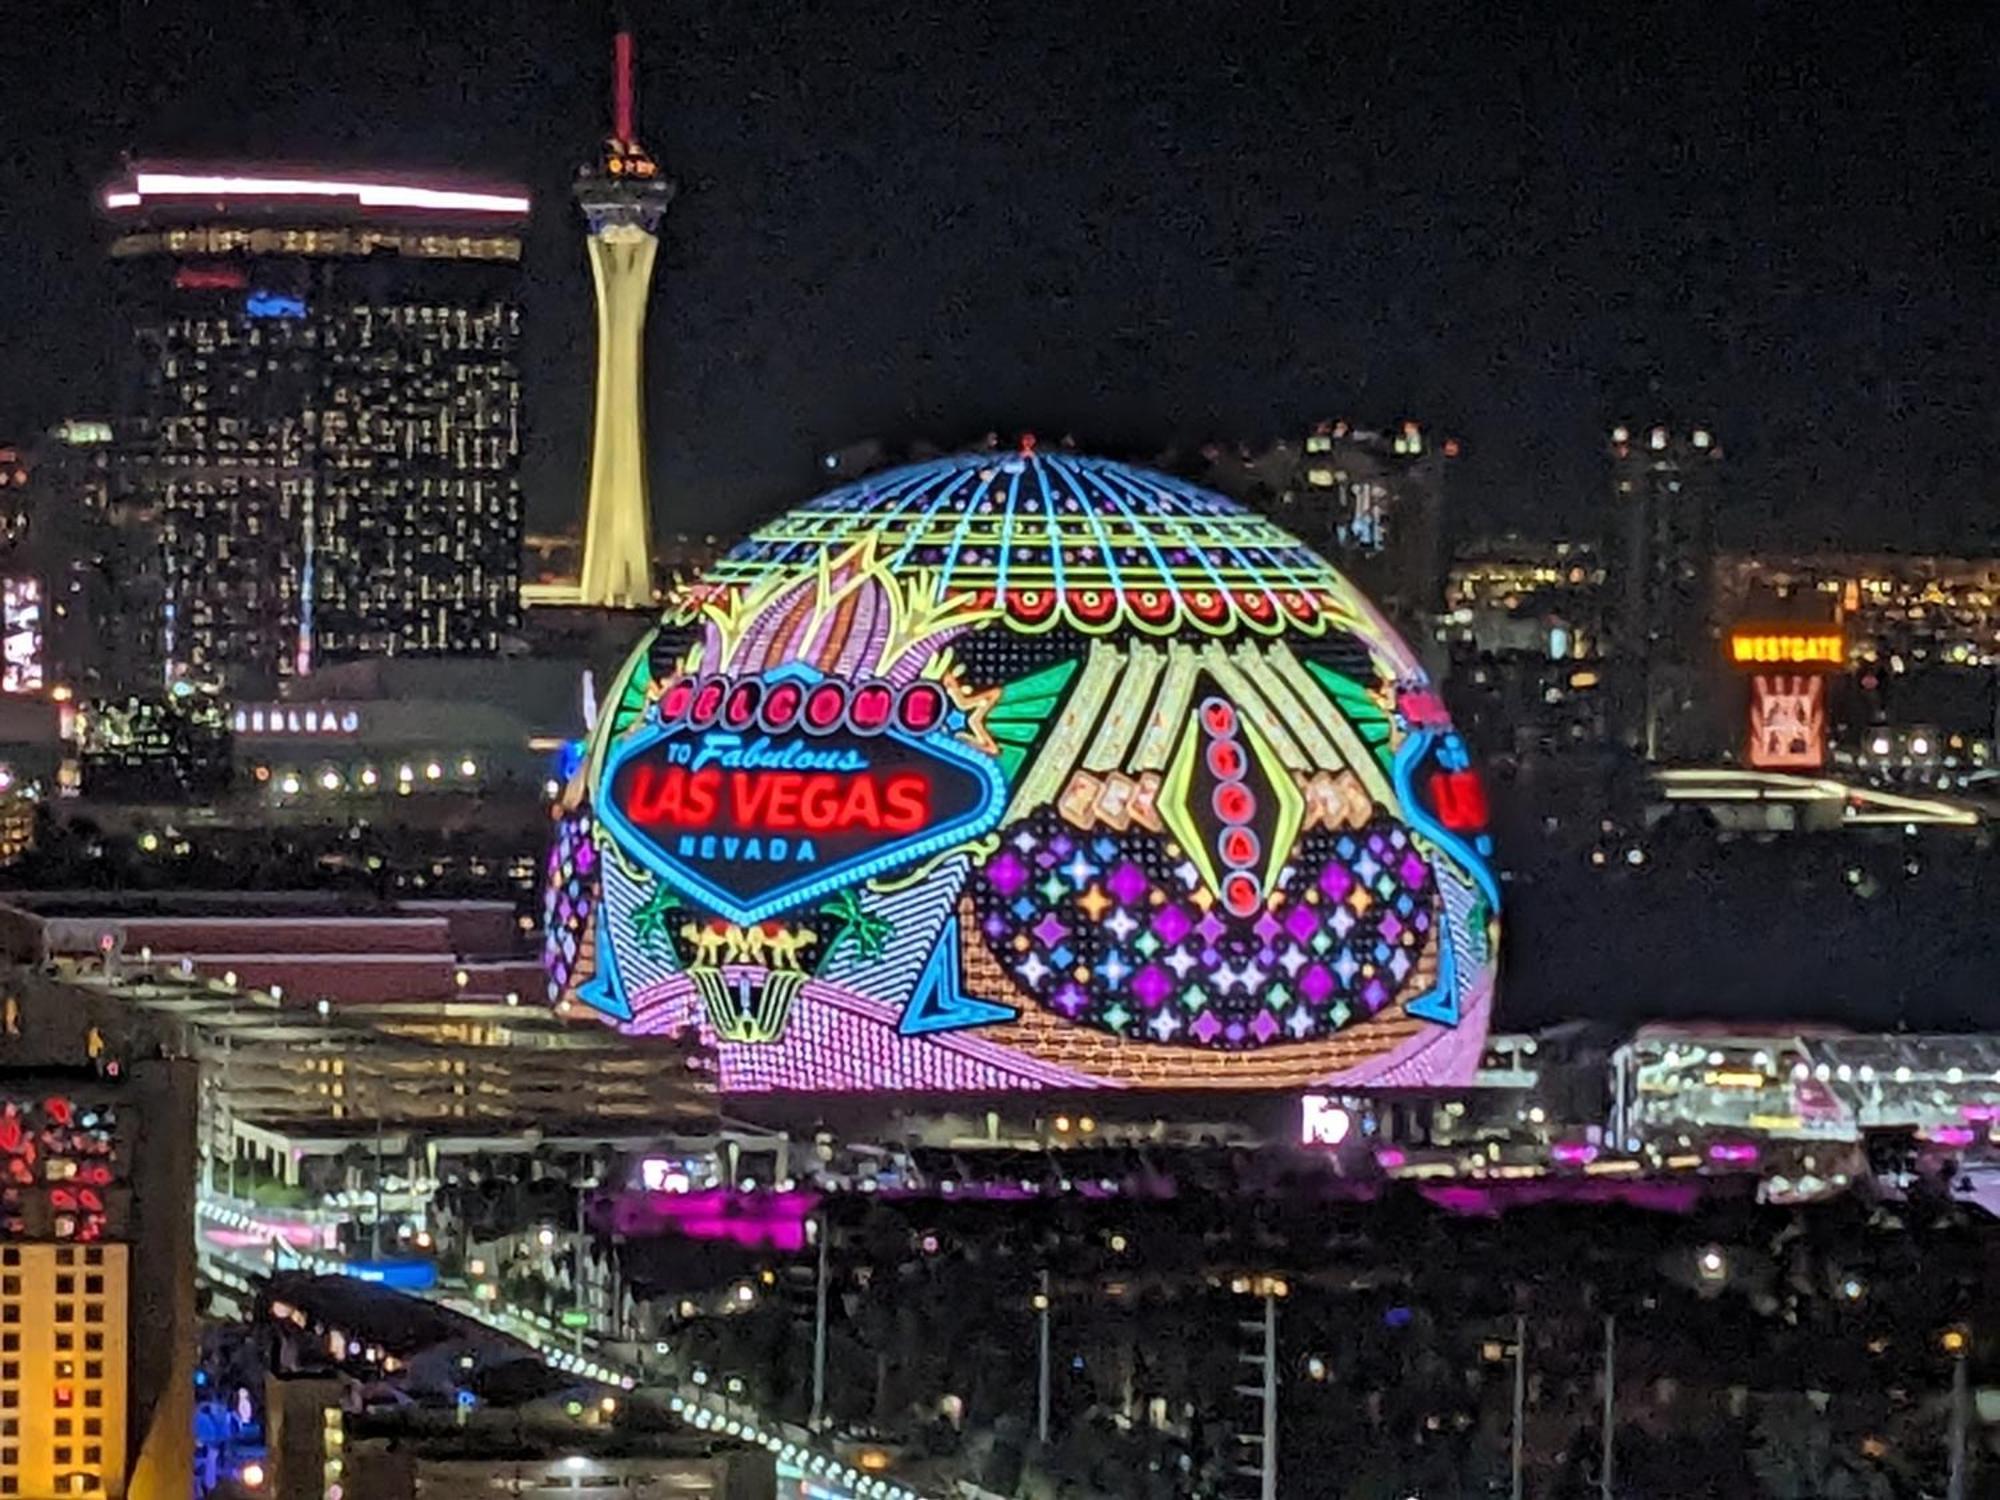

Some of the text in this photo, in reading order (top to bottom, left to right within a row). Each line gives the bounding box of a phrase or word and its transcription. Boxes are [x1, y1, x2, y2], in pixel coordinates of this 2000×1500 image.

[1732, 636, 1842, 662] WESTGATE
[669, 735, 869, 770] TO Fabulous
[627, 764, 930, 834] LAS VEGAS
[679, 836, 817, 862] NEVADA
